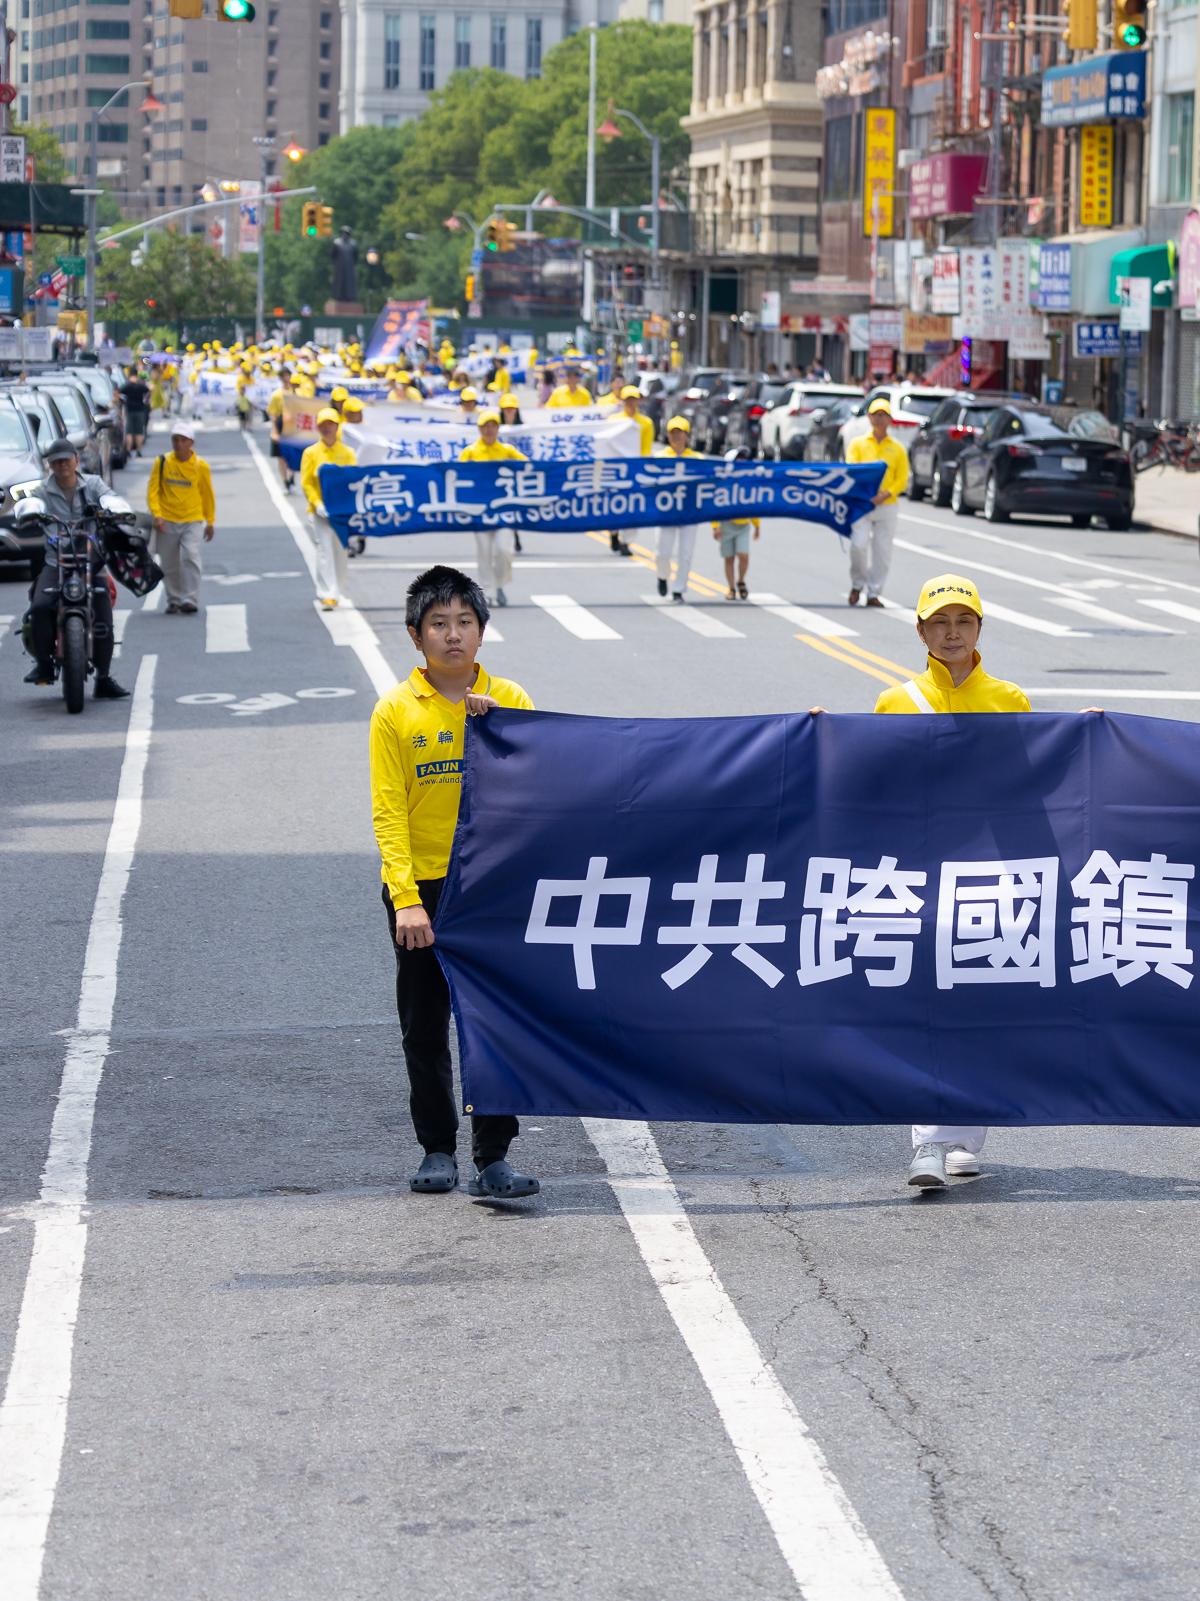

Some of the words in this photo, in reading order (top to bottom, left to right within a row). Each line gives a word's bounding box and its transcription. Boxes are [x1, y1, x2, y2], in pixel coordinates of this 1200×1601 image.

[654, 484, 687, 512] of
[695, 482, 775, 509] Falun
[781, 485, 849, 526] Gong
[412, 730, 453, 749] 法輪
[420, 761, 459, 776] FALUN
